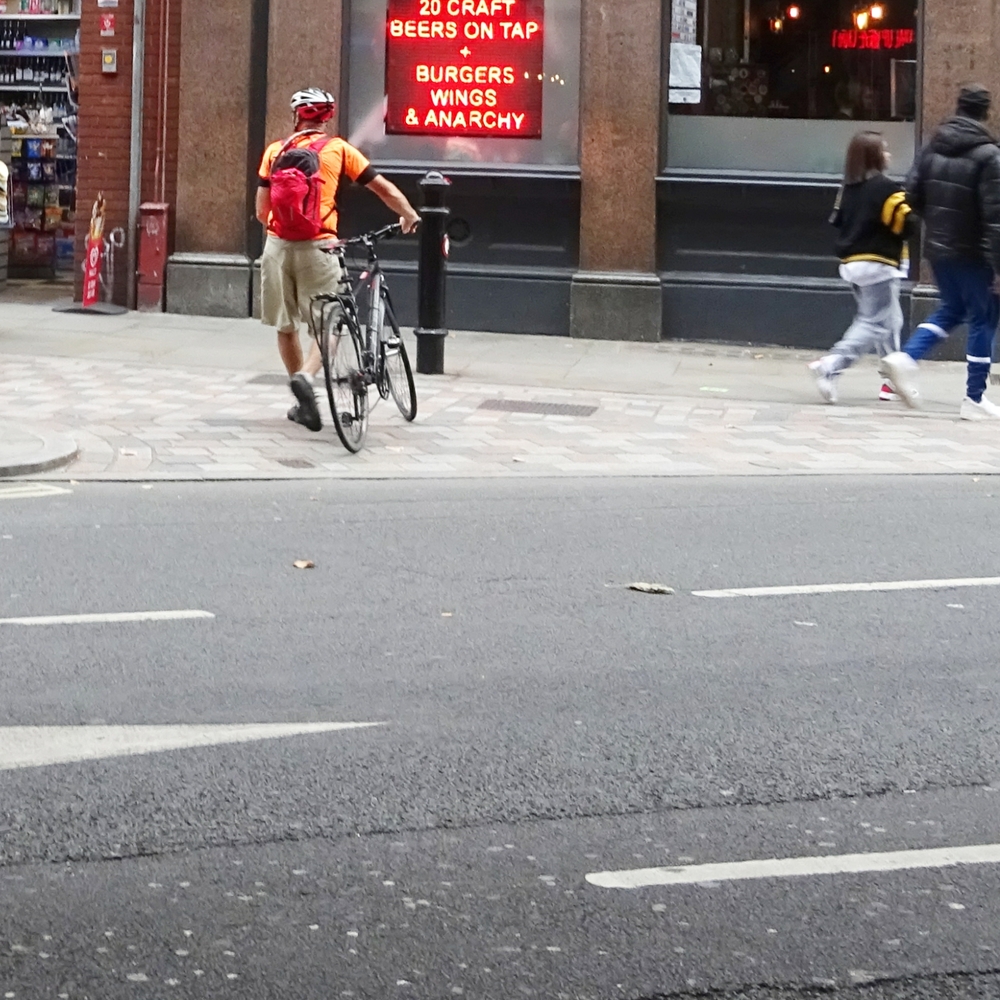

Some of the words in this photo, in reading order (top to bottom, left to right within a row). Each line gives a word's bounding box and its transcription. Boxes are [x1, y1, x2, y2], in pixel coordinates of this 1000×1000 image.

[390, 20, 457, 38] BEERS
[464, 22, 494, 39] ON
[500, 22, 538, 39] TAP
[416, 65, 515, 84] BURGERS
[430, 88, 497, 106] WINGS
[405, 108, 419, 125] &
[424, 109, 525, 129] ANARCHY
